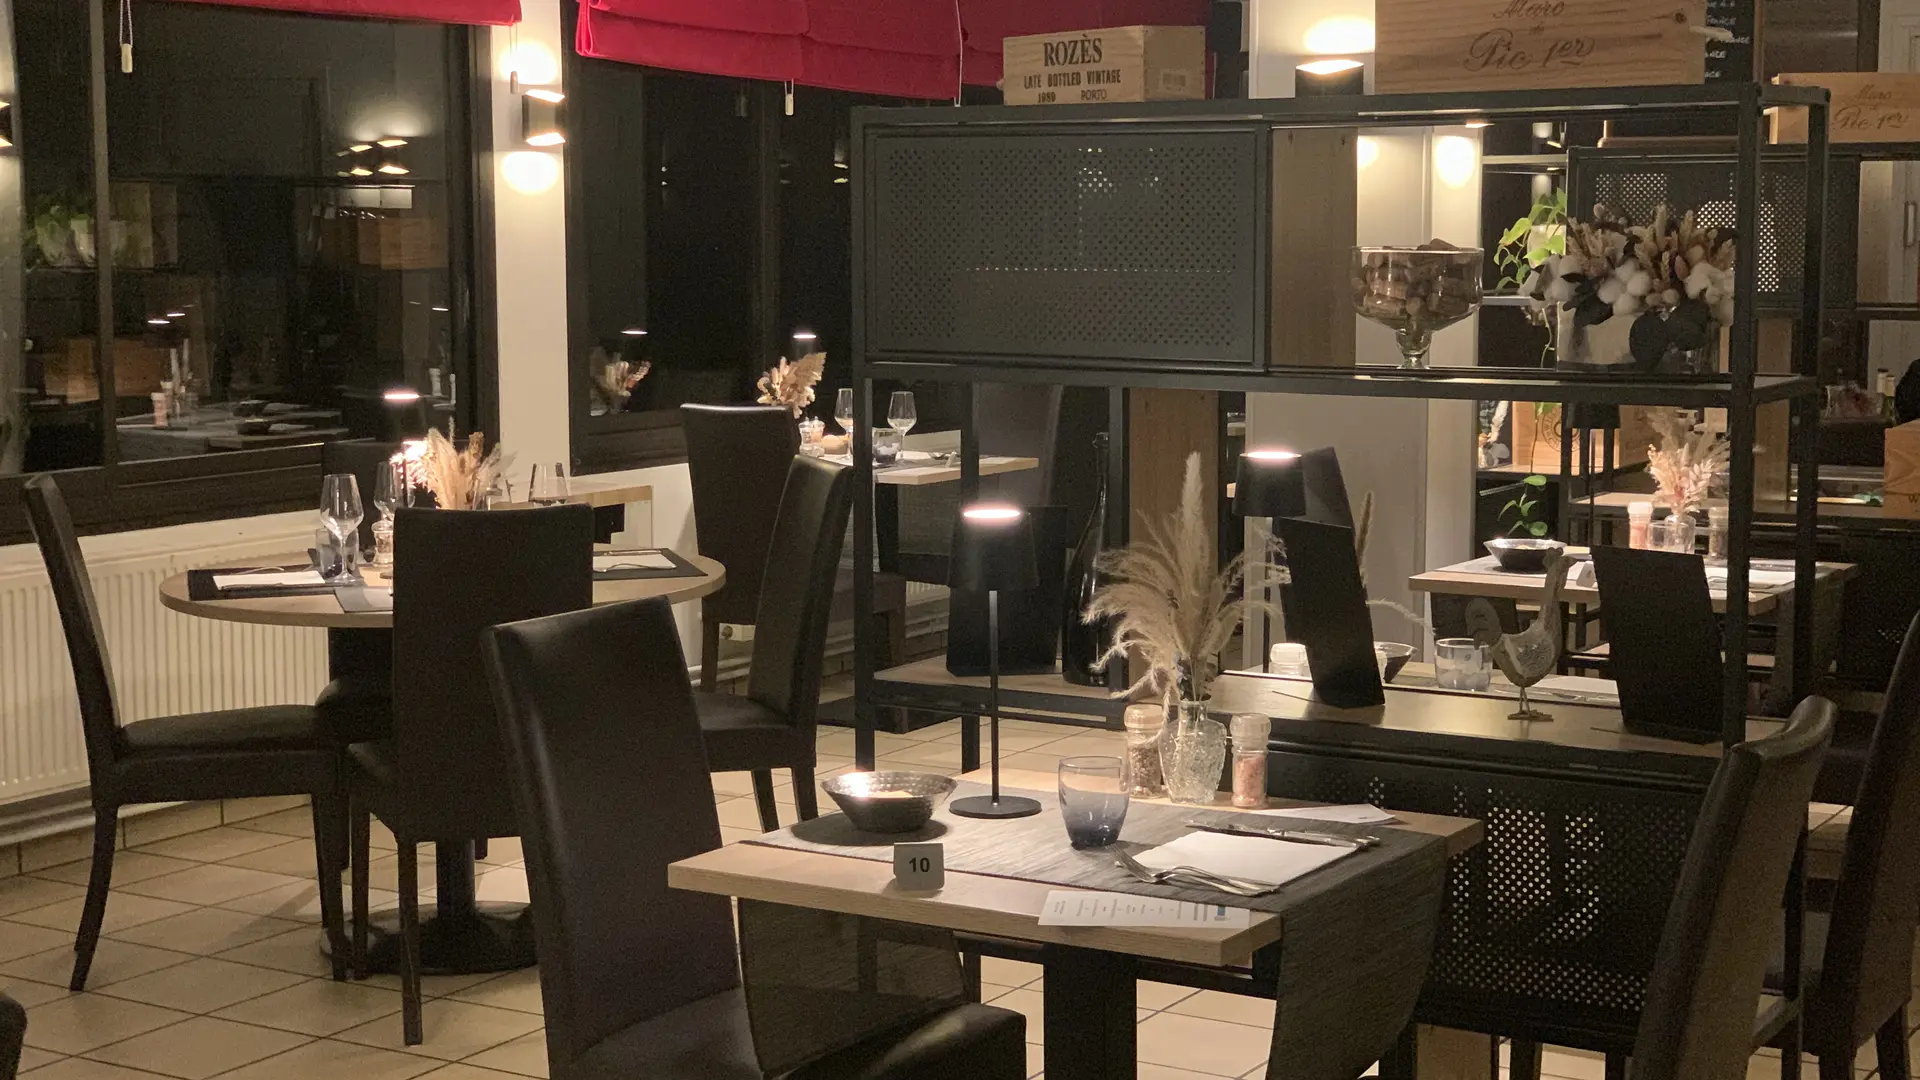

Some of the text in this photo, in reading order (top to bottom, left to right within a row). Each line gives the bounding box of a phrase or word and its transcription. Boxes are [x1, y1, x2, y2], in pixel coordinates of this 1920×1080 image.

[1043, 33, 1103, 67] ROZÈS
[1023, 69, 1122, 90] LATE BOTTLED VINTAGE
[1080, 88, 1108, 101] PORTO
[909, 857, 930, 873] 10
